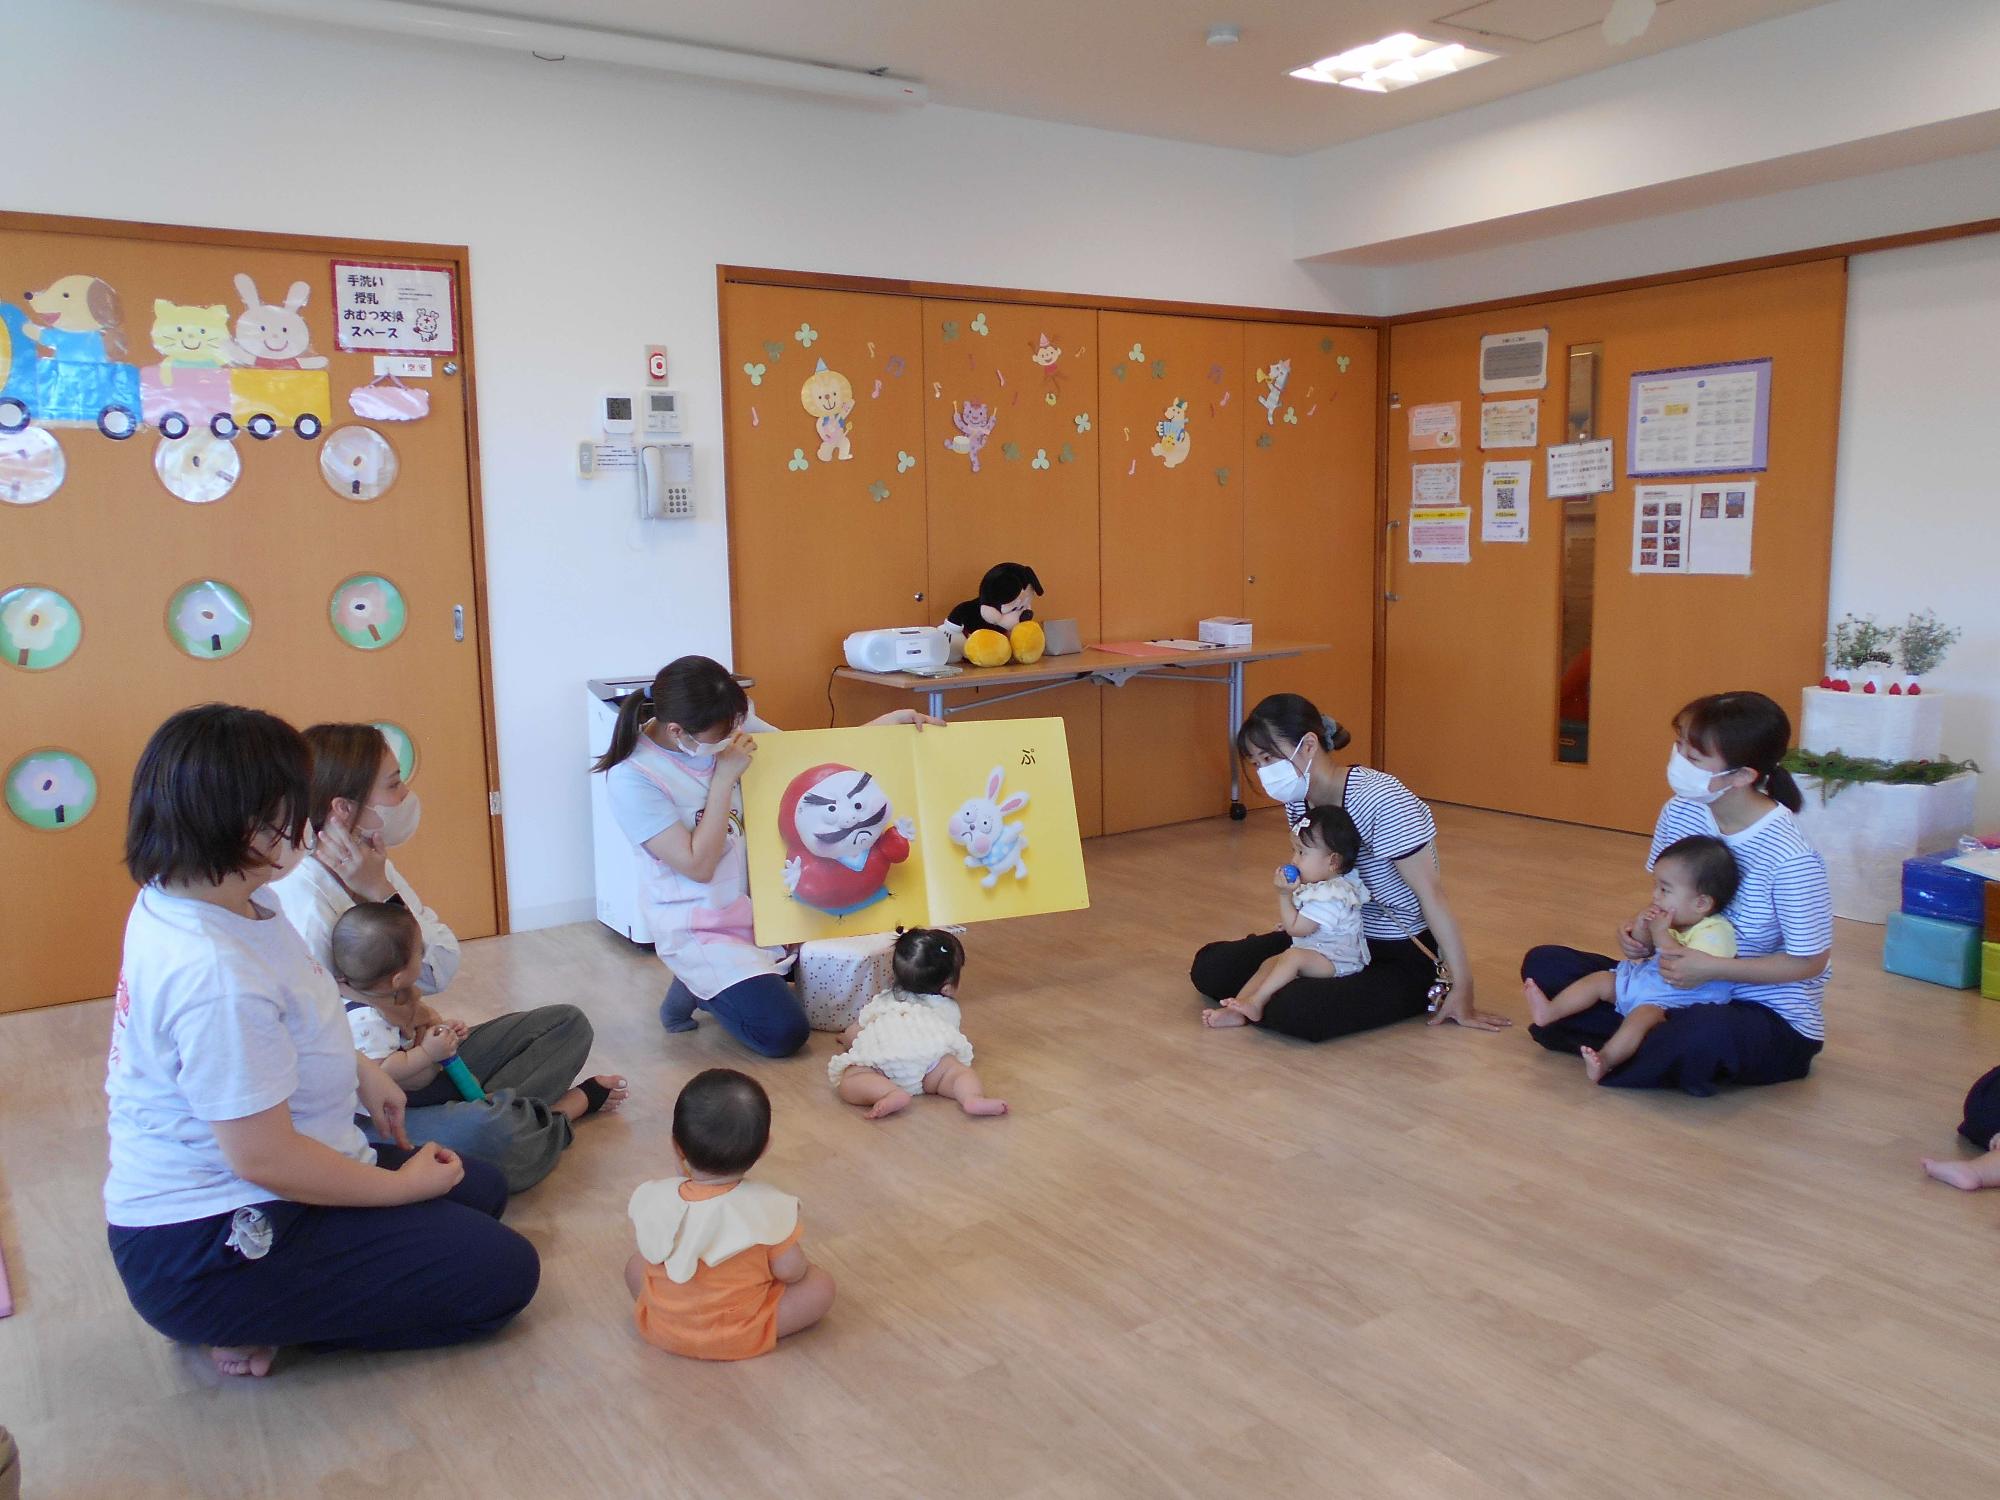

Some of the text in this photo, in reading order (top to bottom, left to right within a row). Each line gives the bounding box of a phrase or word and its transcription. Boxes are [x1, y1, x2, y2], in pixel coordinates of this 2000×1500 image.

[347, 274, 384, 287] 手洗い
[354, 291, 379, 304] 授乳
[343, 308, 404, 322] おむつ交換
[351, 326, 398, 338] スペース
[1021, 748, 1036, 765] ぷ
